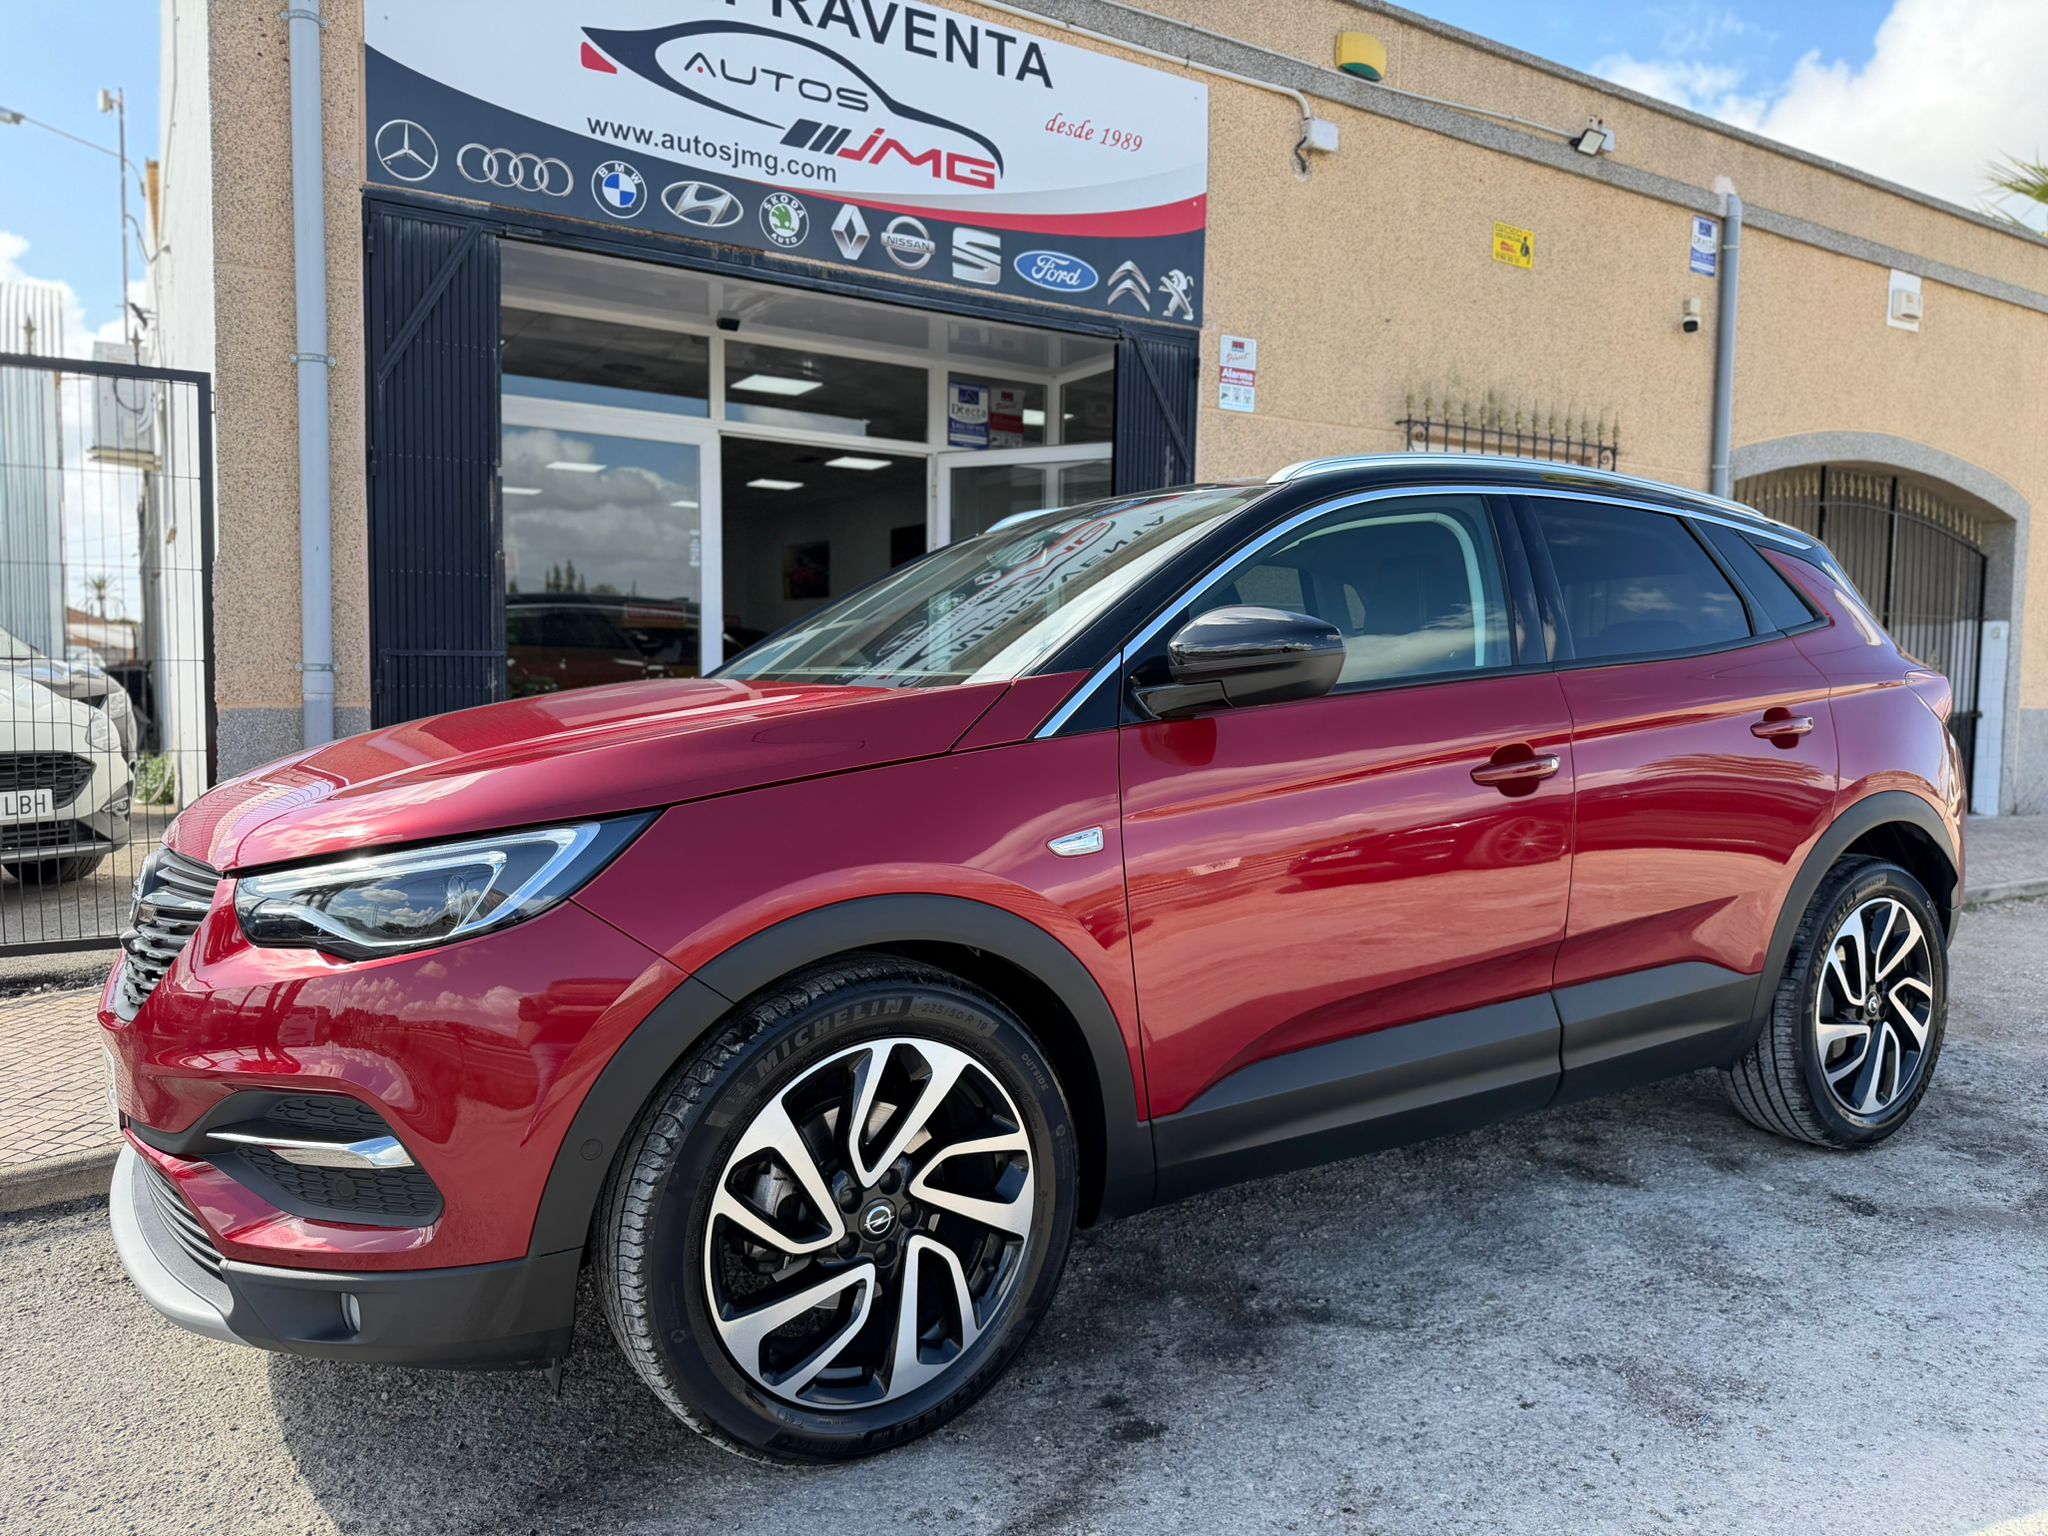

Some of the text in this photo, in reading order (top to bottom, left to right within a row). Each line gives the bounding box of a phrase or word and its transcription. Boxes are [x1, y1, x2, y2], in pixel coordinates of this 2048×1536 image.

[725, 0, 1054, 90] AVENTA
[684, 52, 870, 113] AUTOS
[586, 116, 837, 183] www.autosjmg.com
[1045, 112, 1143, 152] desde 1989
[598, 163, 642, 185] BMW
[771, 233, 797, 245] AUTO
[886, 235, 930, 250] NISSAN
[1031, 254, 1082, 286] Ford
[756, 997, 905, 1079] MICHELIN
[921, 1001, 965, 1020] 235/50
[965, 1014, 975, 1025] R
[1020, 1053, 1050, 1092] OUTSIDE
